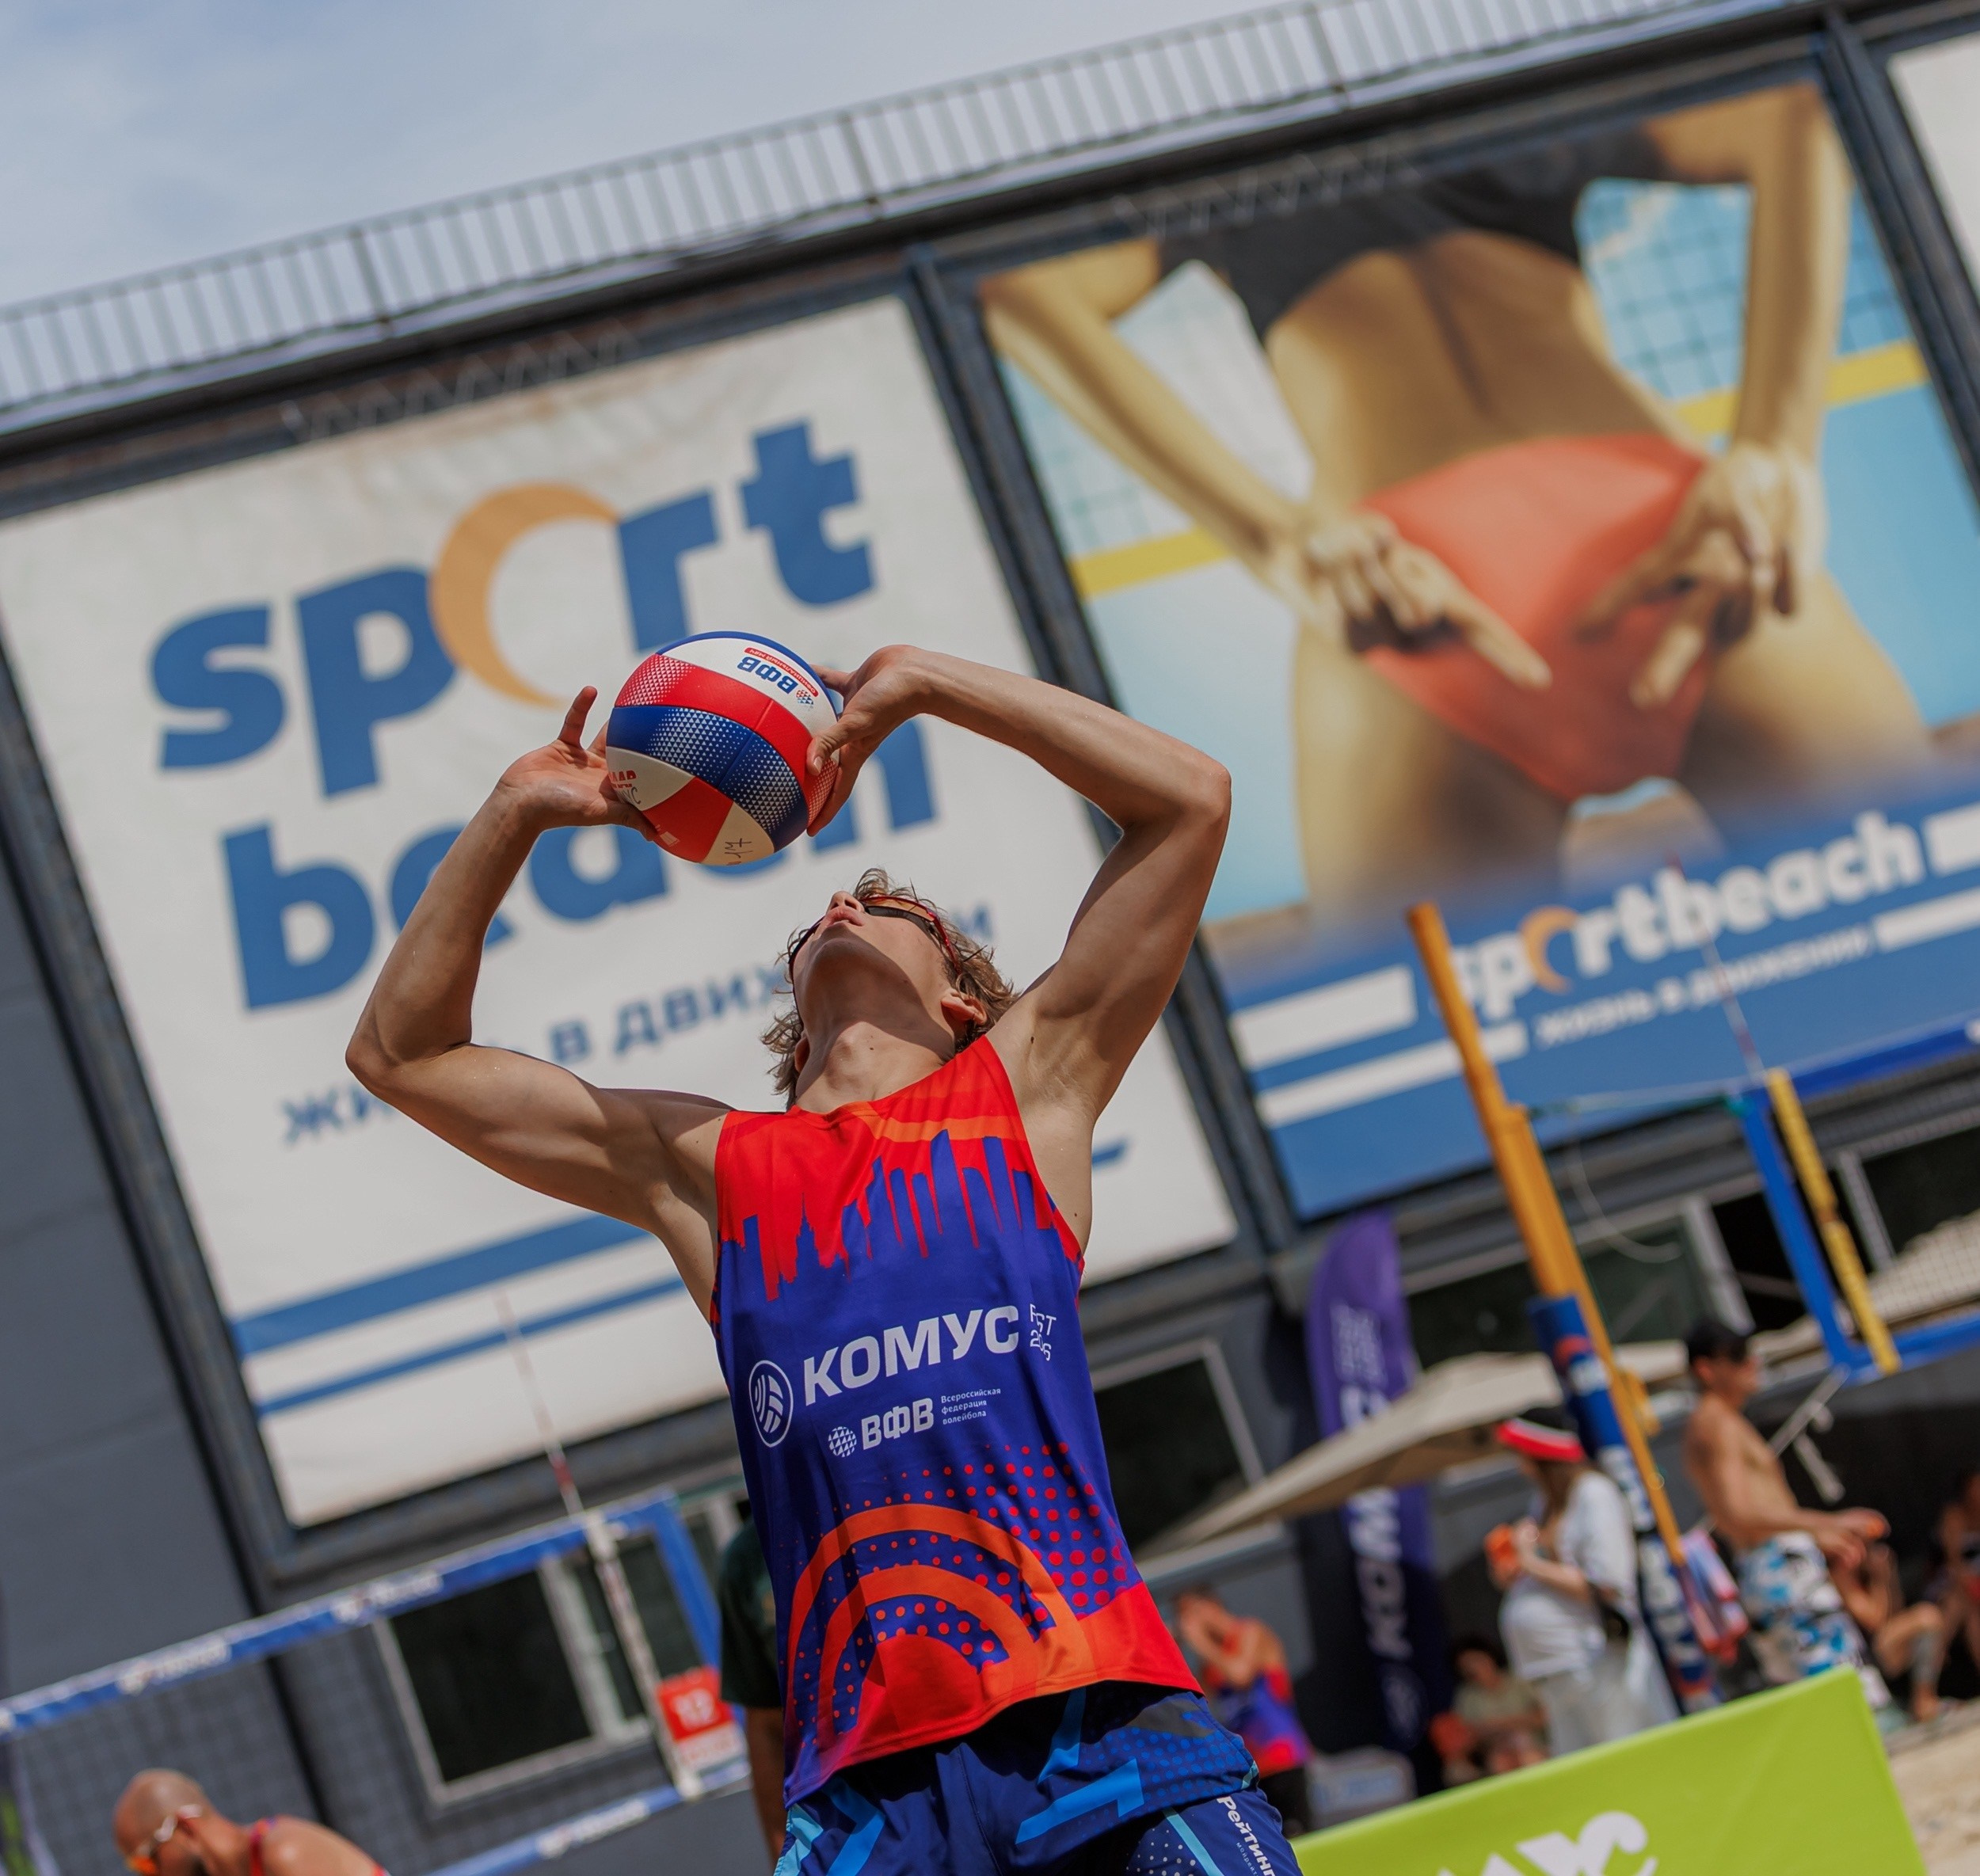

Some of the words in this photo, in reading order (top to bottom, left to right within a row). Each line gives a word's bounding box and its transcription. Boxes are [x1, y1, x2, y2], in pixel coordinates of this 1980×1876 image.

[737, 656, 799, 694] ВФВ
[802, 1305, 1020, 1407] КОМУС
[941, 1388, 1001, 1404] Всероссийская
[941, 1400, 988, 1415] федерация
[861, 1397, 935, 1451] ВФВ
[942, 1410, 987, 1425] волейбола
